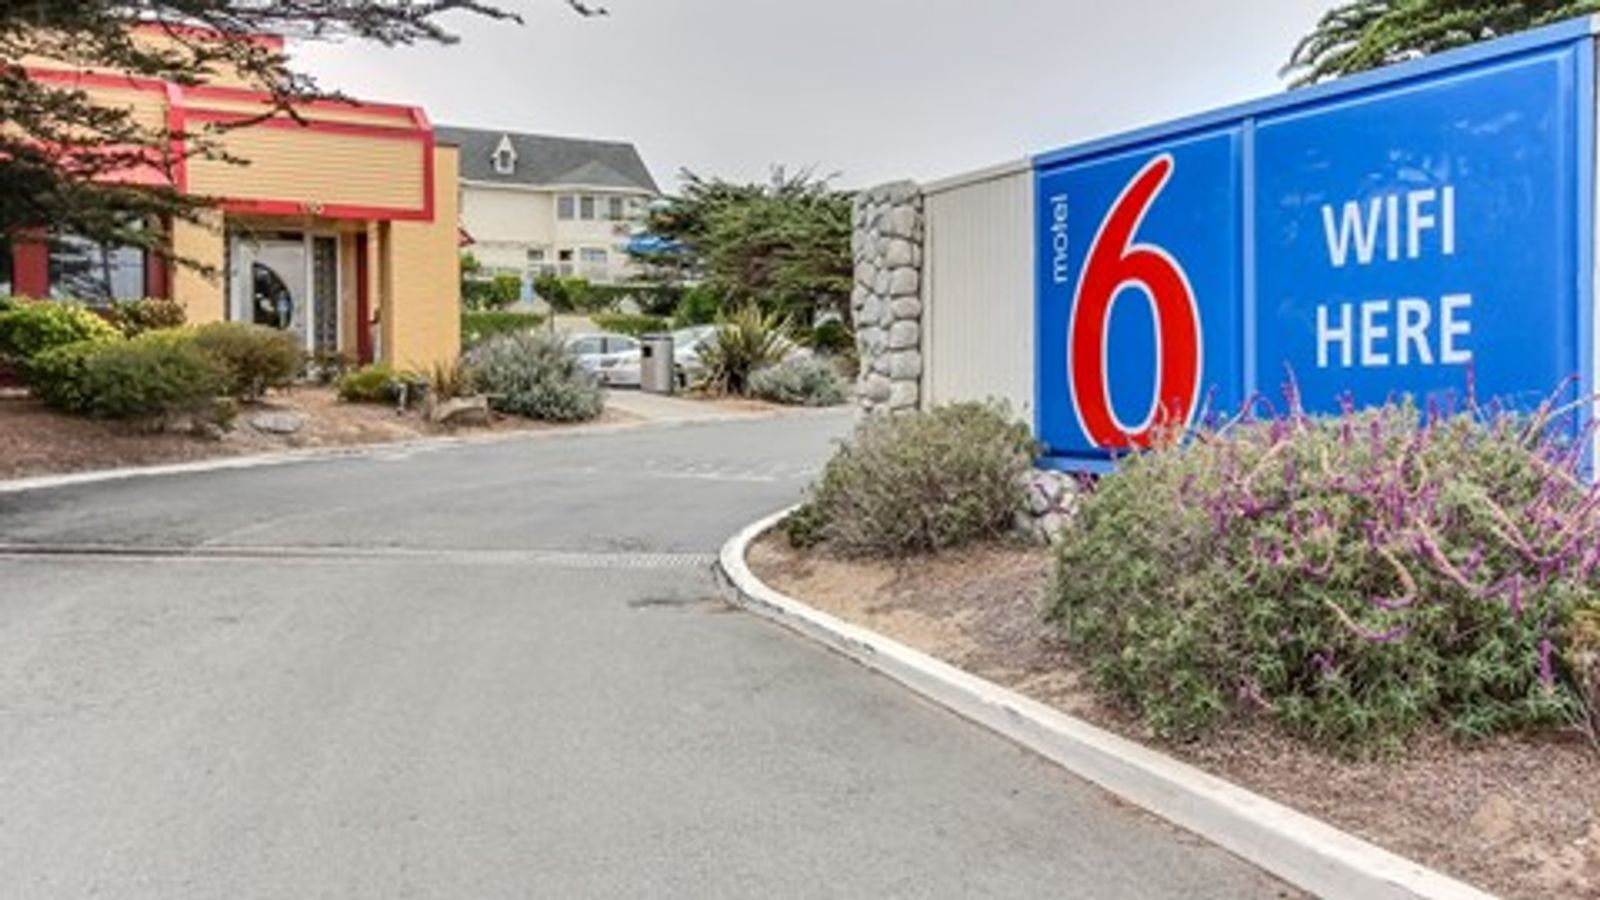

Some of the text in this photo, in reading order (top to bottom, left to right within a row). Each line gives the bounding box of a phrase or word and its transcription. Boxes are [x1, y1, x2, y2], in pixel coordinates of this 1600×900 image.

[1322, 186, 1454, 268] WIFI
[1050, 153, 1203, 449] motel 6
[1316, 293, 1472, 368] HERE
